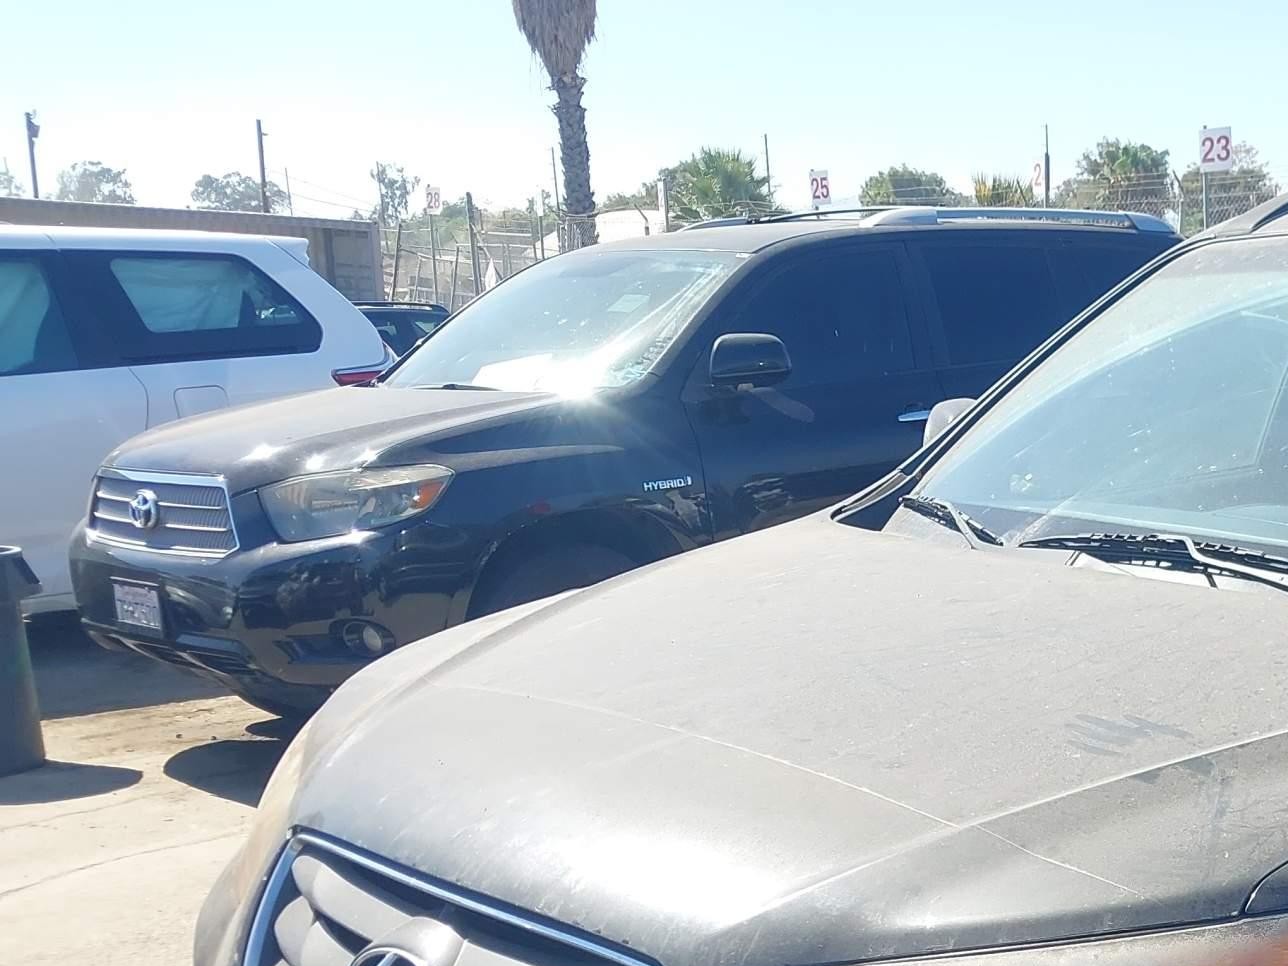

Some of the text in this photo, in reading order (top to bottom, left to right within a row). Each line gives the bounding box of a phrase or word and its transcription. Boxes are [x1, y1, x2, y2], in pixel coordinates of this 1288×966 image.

[1201, 135, 1230, 163] 23
[811, 177, 829, 200] 25
[426, 191, 441, 209] 28
[643, 478, 686, 492] HYBRID
